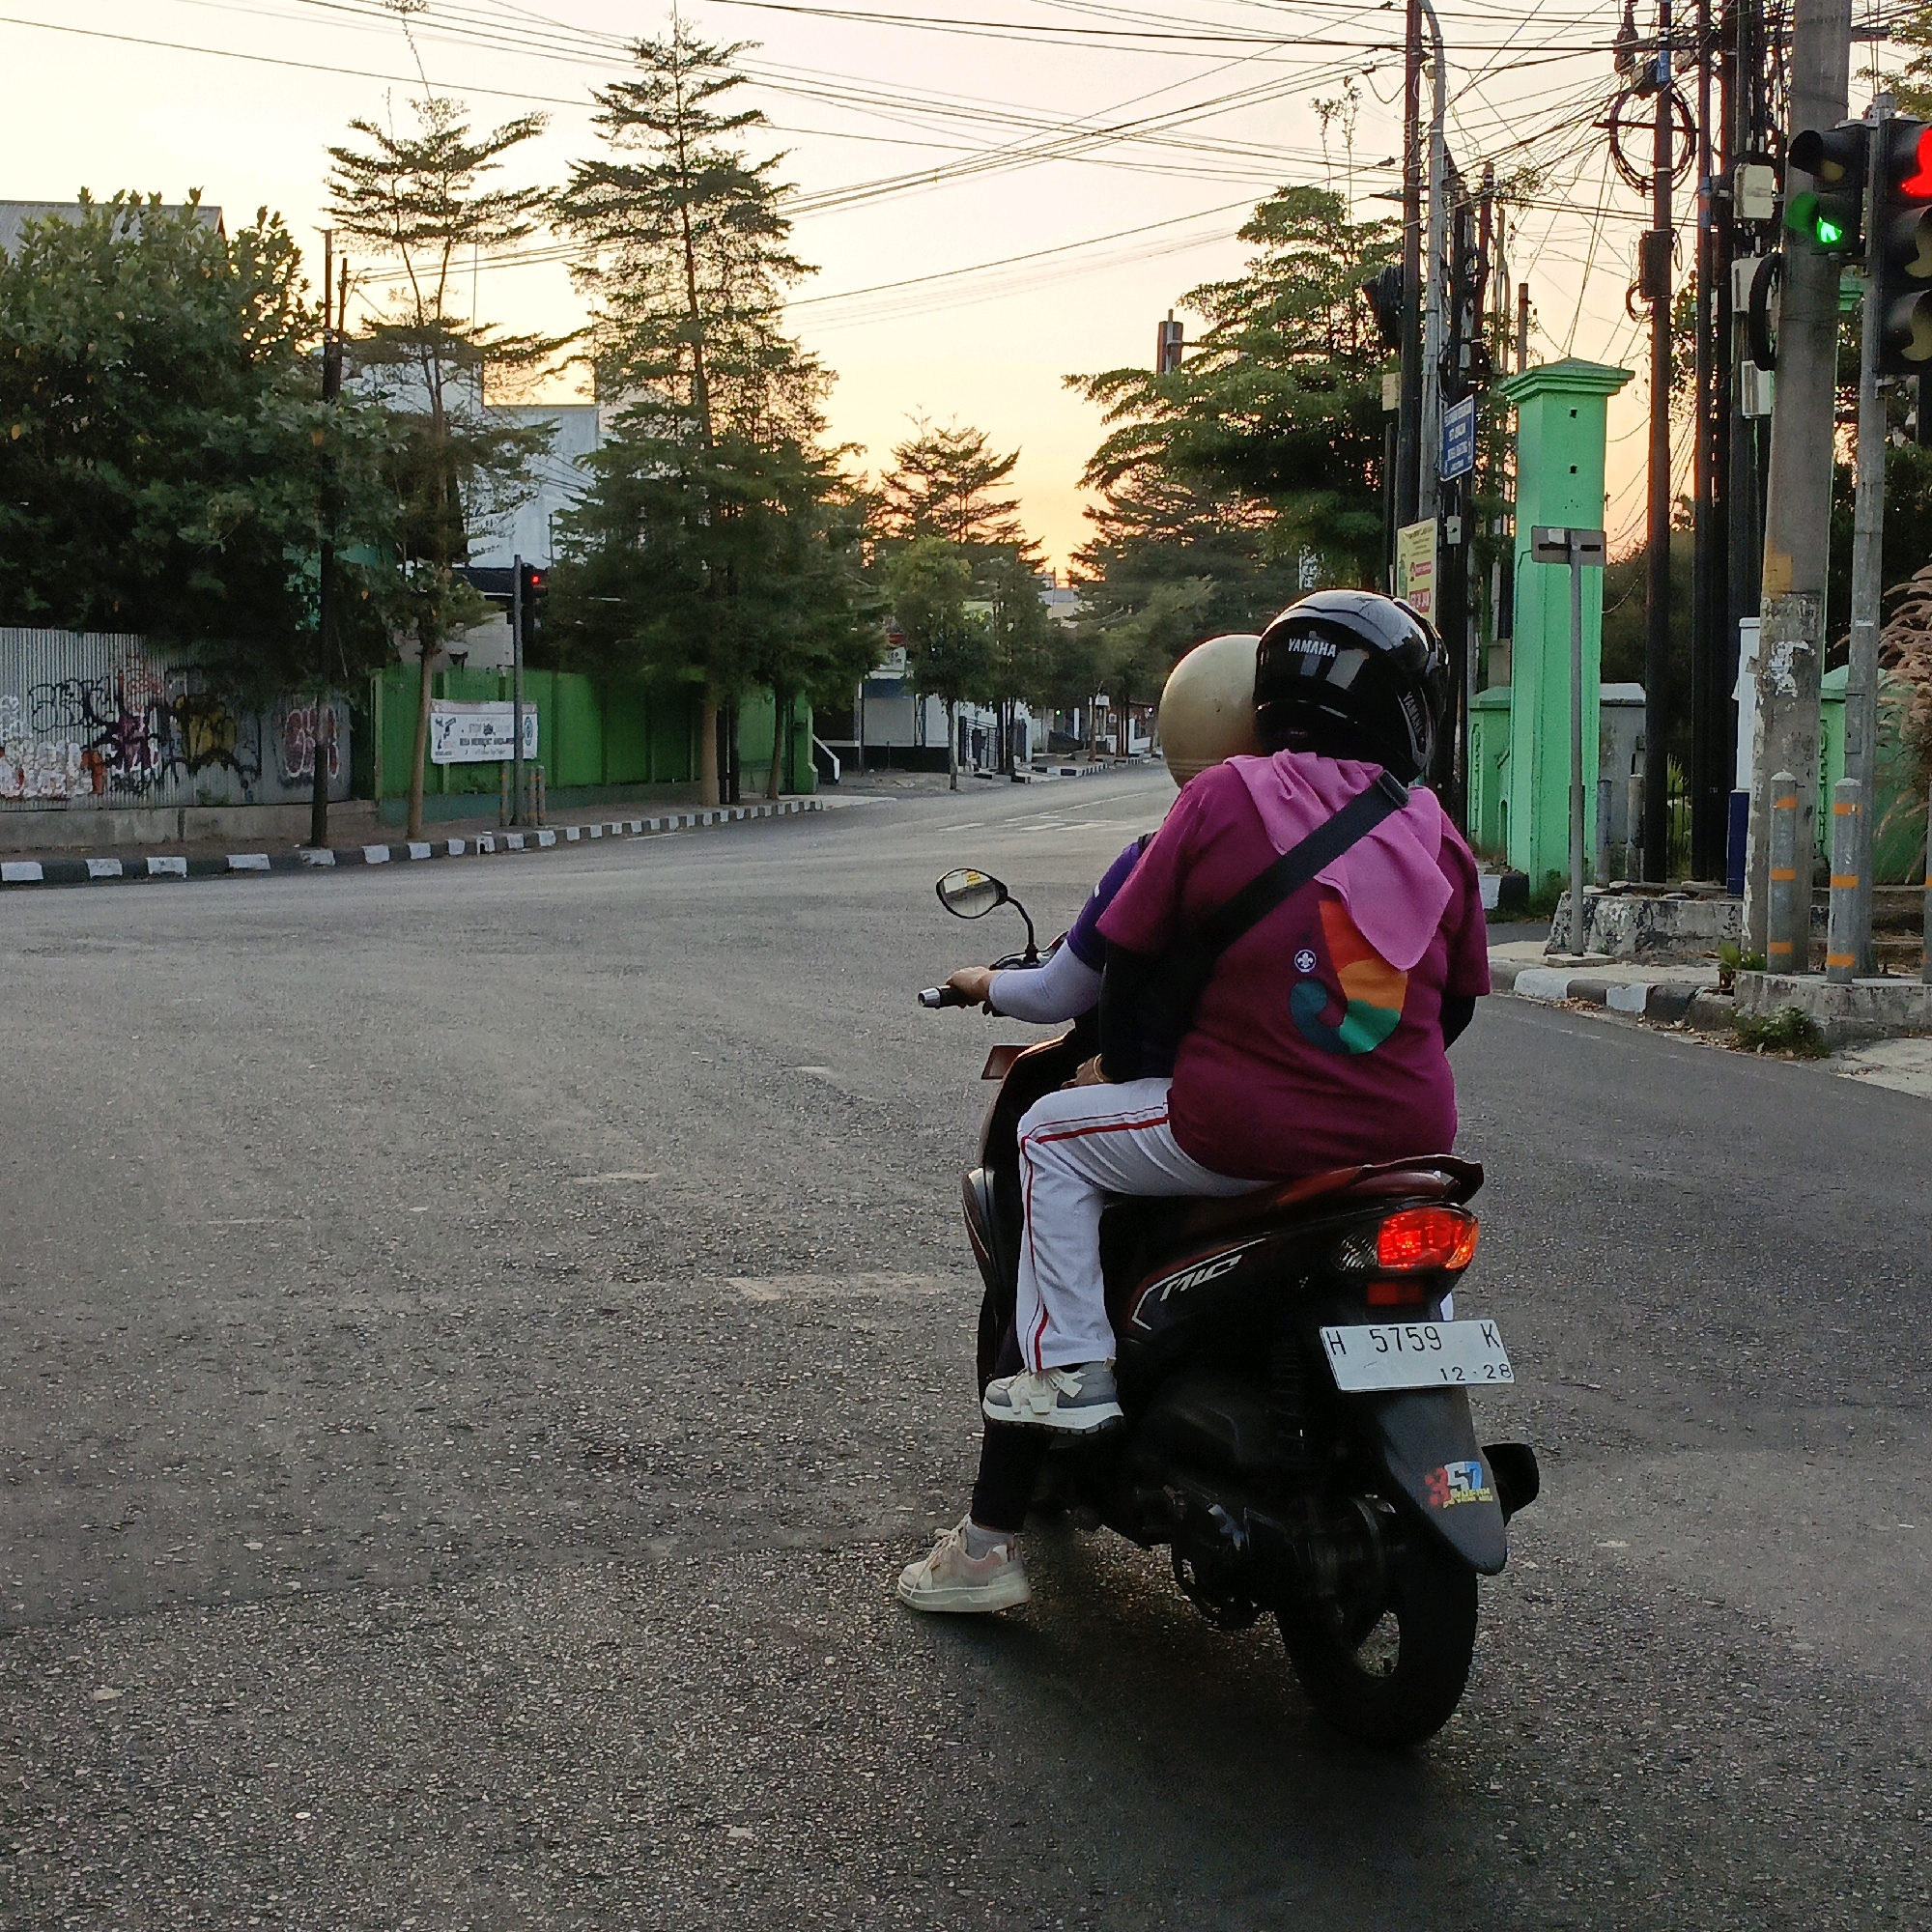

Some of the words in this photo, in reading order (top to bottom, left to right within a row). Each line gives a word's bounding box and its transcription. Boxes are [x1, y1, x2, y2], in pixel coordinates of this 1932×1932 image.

[1288, 638, 1337, 658] YAMAHA
[1403, 691, 1424, 736] YAMAHA
[1325, 1329, 1347, 1355] H
[1369, 1325, 1442, 1353] 5759
[1479, 1322, 1500, 1349] K
